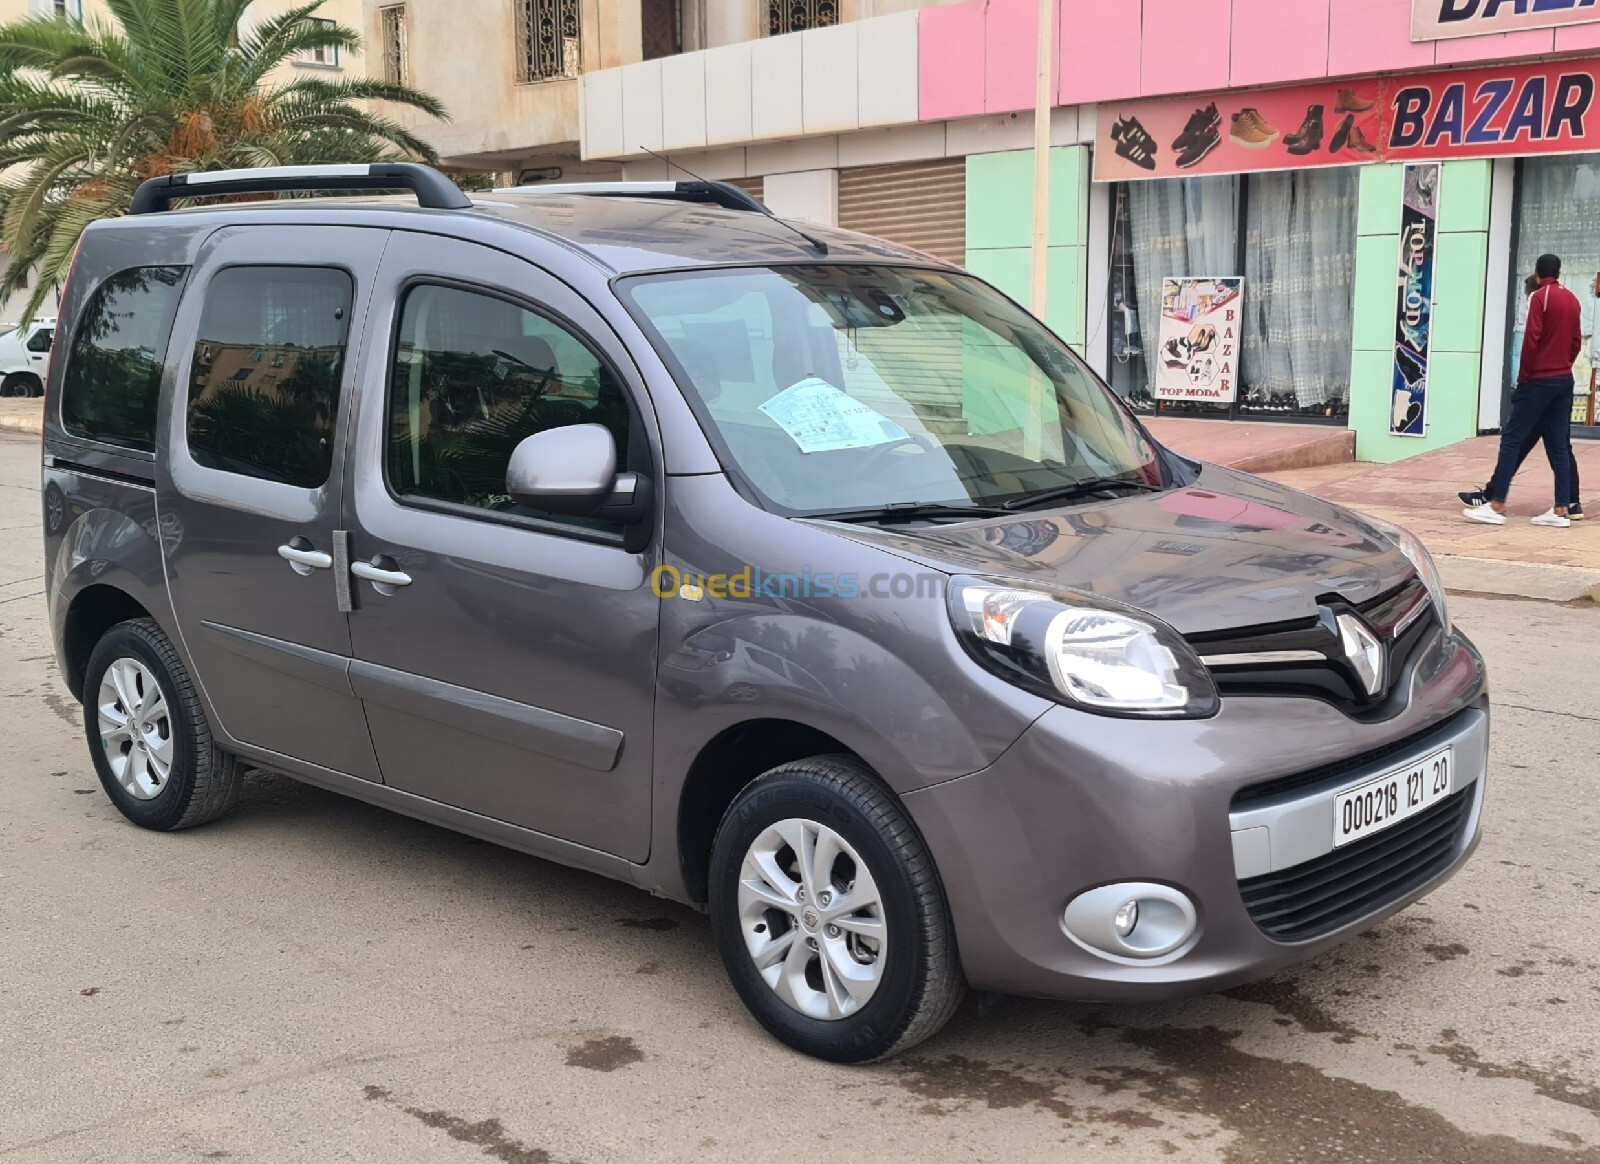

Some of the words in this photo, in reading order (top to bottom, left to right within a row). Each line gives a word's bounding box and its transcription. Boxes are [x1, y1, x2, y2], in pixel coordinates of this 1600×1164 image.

[1388, 72, 1595, 149] BAZAR
[1409, 218, 1426, 266] TOP
[1220, 309, 1235, 391] BAZAR
[1159, 387, 1183, 396] TOP
[1185, 388, 1220, 397] MODA
[1342, 781, 1398, 835] 000218
[1406, 767, 1424, 809] 121
[1432, 756, 1448, 796] 20
